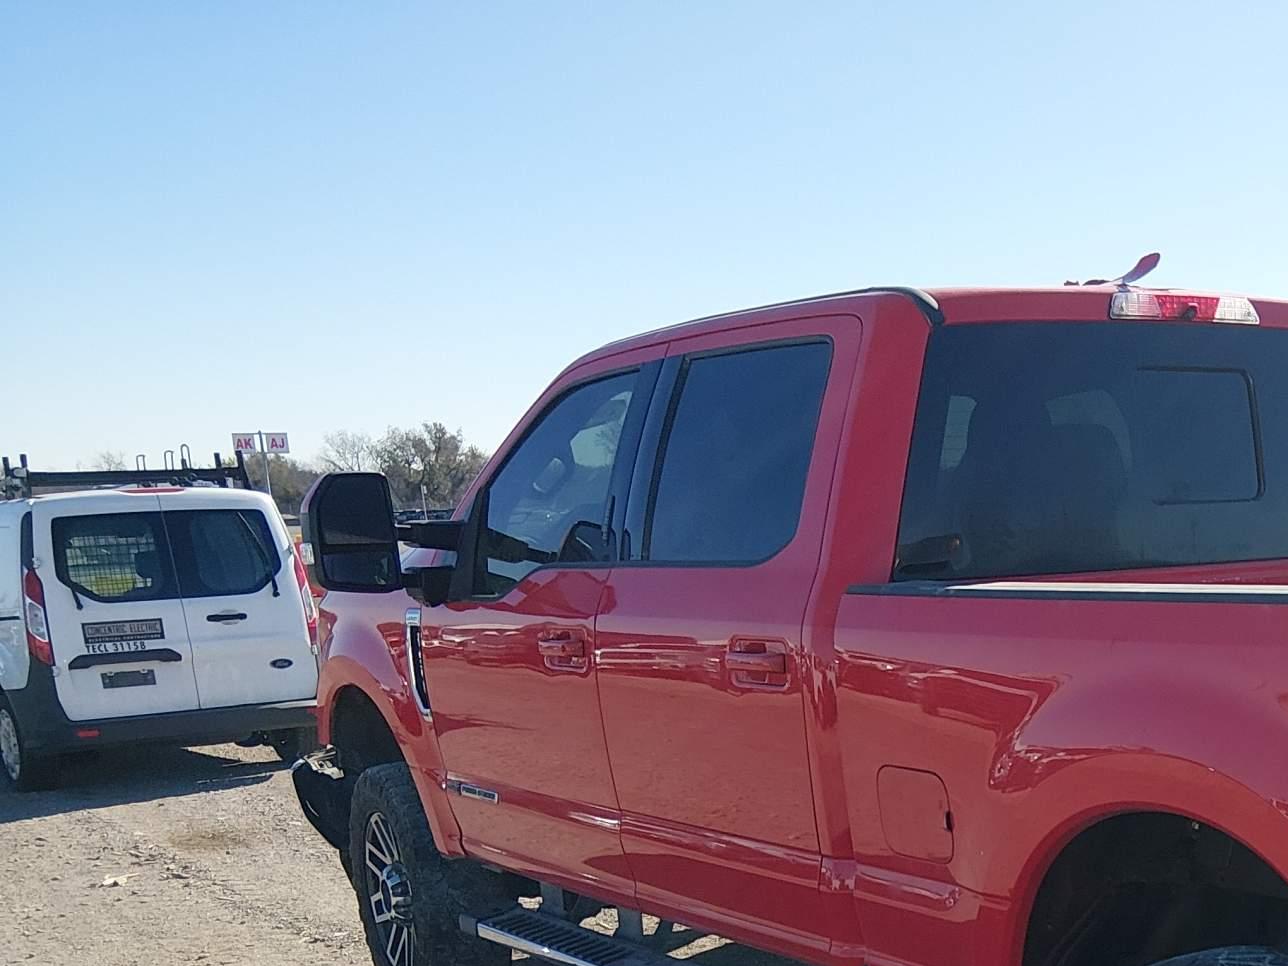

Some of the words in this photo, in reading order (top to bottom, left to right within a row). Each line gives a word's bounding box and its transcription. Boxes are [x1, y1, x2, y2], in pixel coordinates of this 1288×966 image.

[236, 438, 253, 450] AK
[271, 438, 285, 449] AJ
[129, 622, 160, 633] ELECTRIC
[87, 643, 109, 654] TECL
